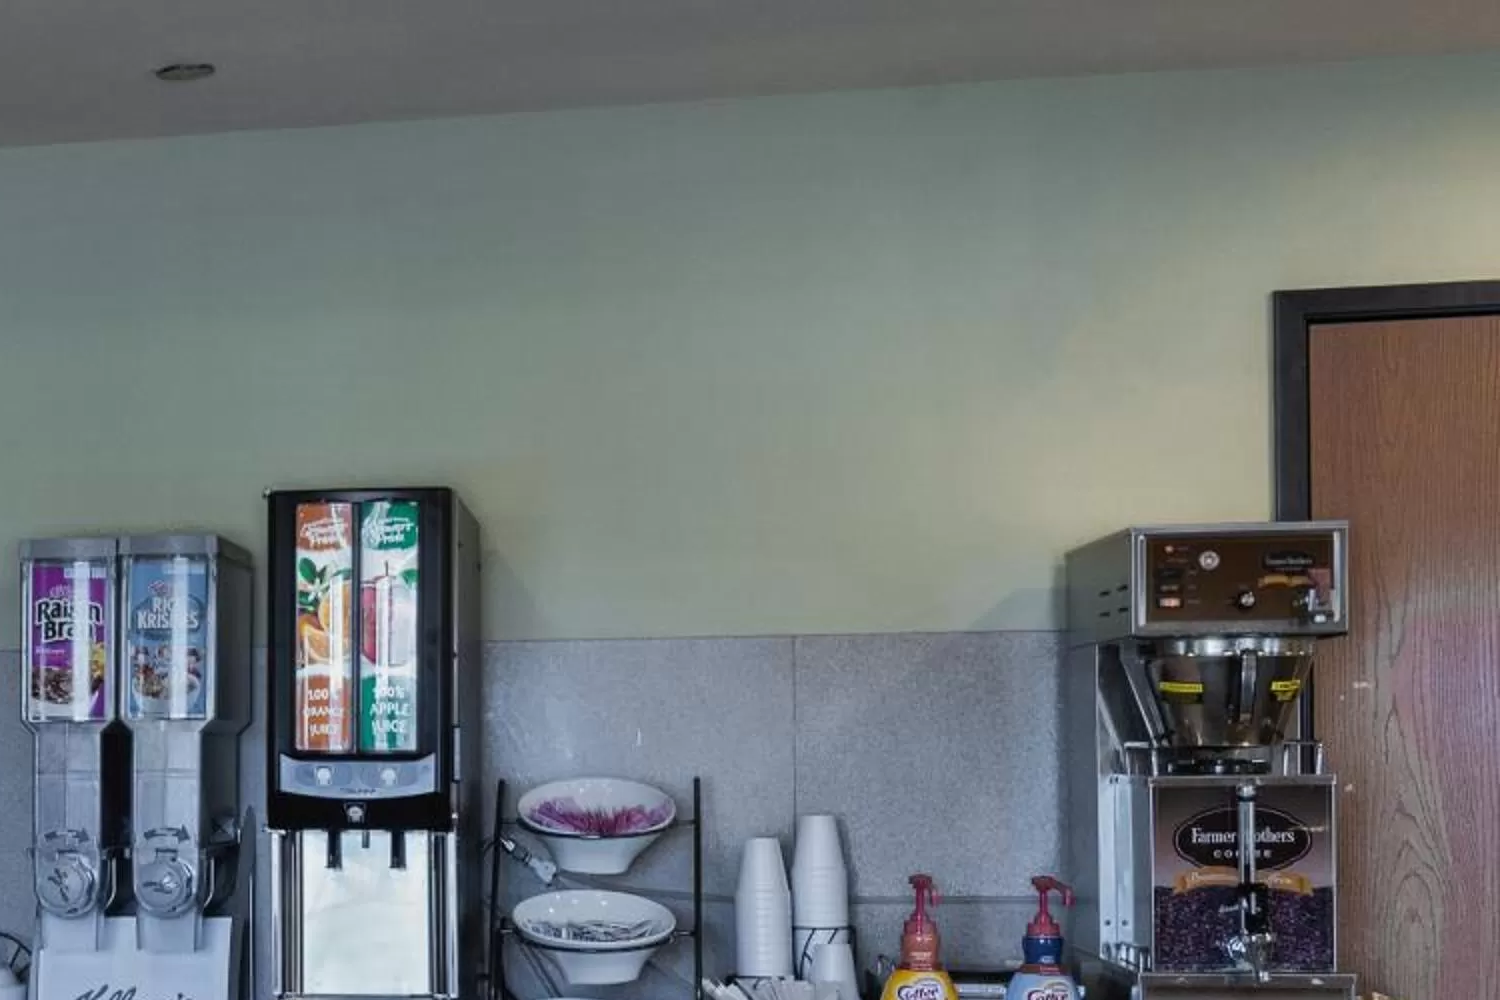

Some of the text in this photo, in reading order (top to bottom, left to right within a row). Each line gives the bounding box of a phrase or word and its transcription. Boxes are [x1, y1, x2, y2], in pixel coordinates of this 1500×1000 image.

[37, 600, 101, 622] Raisn
[370, 702, 410, 716] APPLE
[1191, 825, 1296, 844] Farmer others
[1213, 849, 1272, 859] COE
